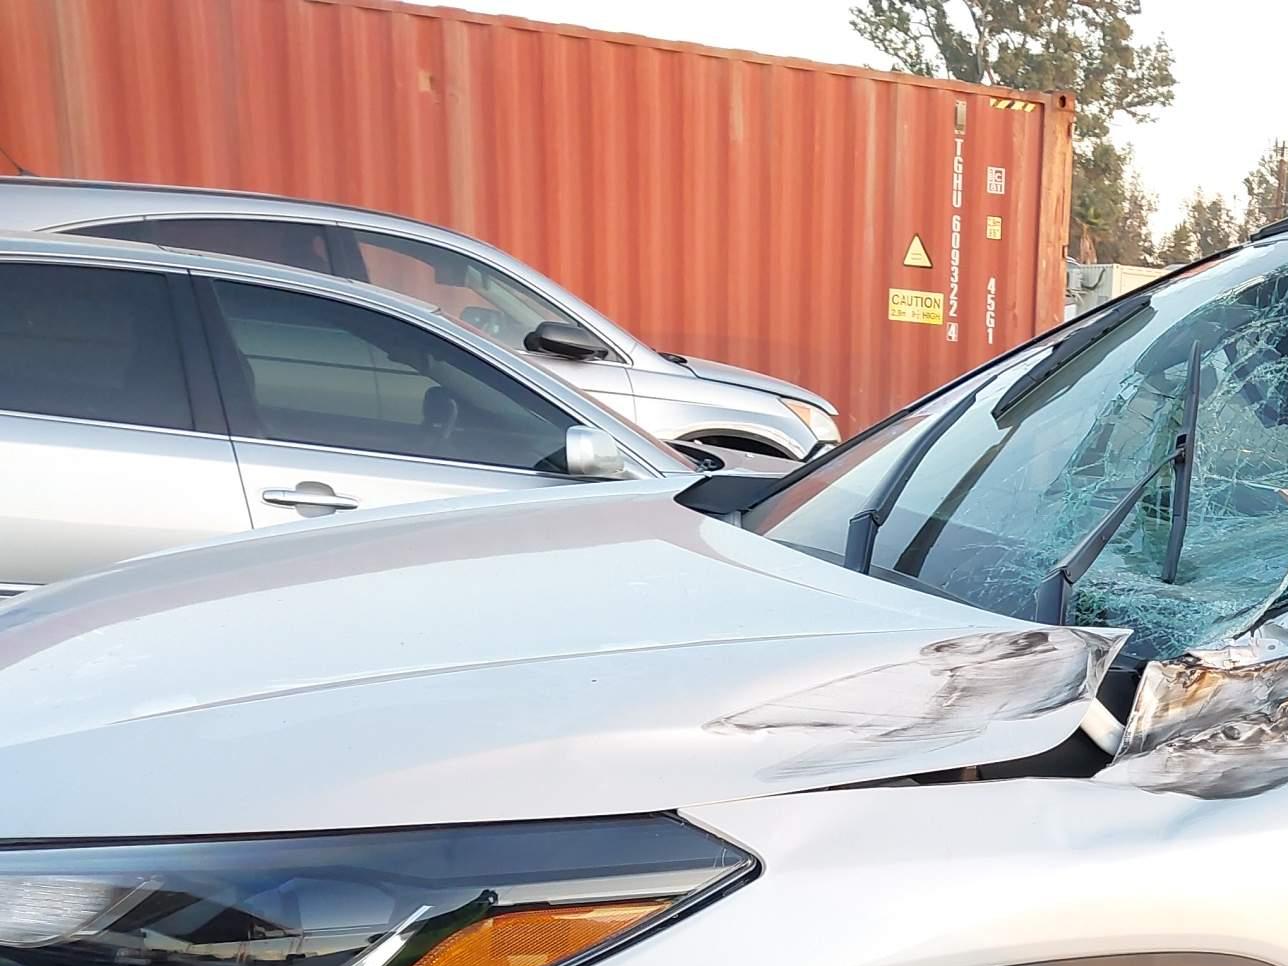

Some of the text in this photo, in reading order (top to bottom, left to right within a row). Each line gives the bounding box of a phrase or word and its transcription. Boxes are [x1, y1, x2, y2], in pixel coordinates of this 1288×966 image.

[952, 138, 964, 208] TGHU
[949, 214, 961, 317] 609322
[891, 294, 941, 309] CAUTION
[986, 277, 996, 345] 45G1
